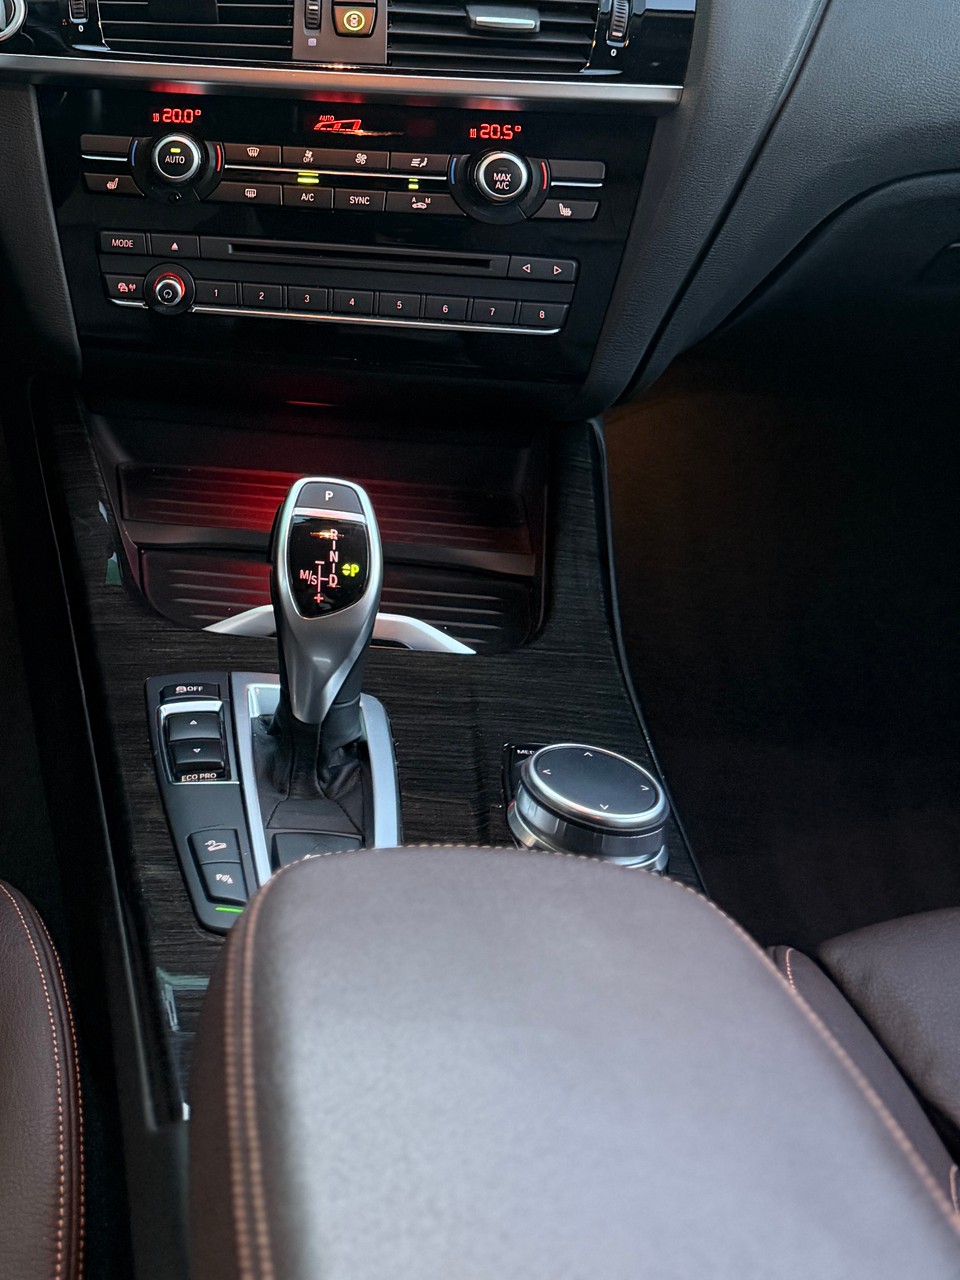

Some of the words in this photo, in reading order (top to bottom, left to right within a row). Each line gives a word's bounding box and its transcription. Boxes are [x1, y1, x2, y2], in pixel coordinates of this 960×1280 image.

[164, 155, 185, 165] AUTO
[493, 172, 512, 181] MAX
[495, 181, 510, 190] A/C
[301, 193, 315, 202] A/C
[349, 196, 370, 206] SYNC
[111, 239, 134, 248] MODE
[214, 289, 218, 297] 1
[258, 291, 265, 300] 2
[304, 294, 310, 303] 3
[349, 297, 355, 306] 4
[396, 300, 403, 309] 5
[442, 304, 449, 313] 6
[490, 308, 495, 316] 7
[539, 310, 545, 319] 8
[325, 491, 333, 501] P
[330, 529, 338, 540] R
[329, 551, 338, 563] N
[299, 570, 317, 585] M/S
[329, 574, 338, 586] D
[181, 774, 198, 782] ECO
